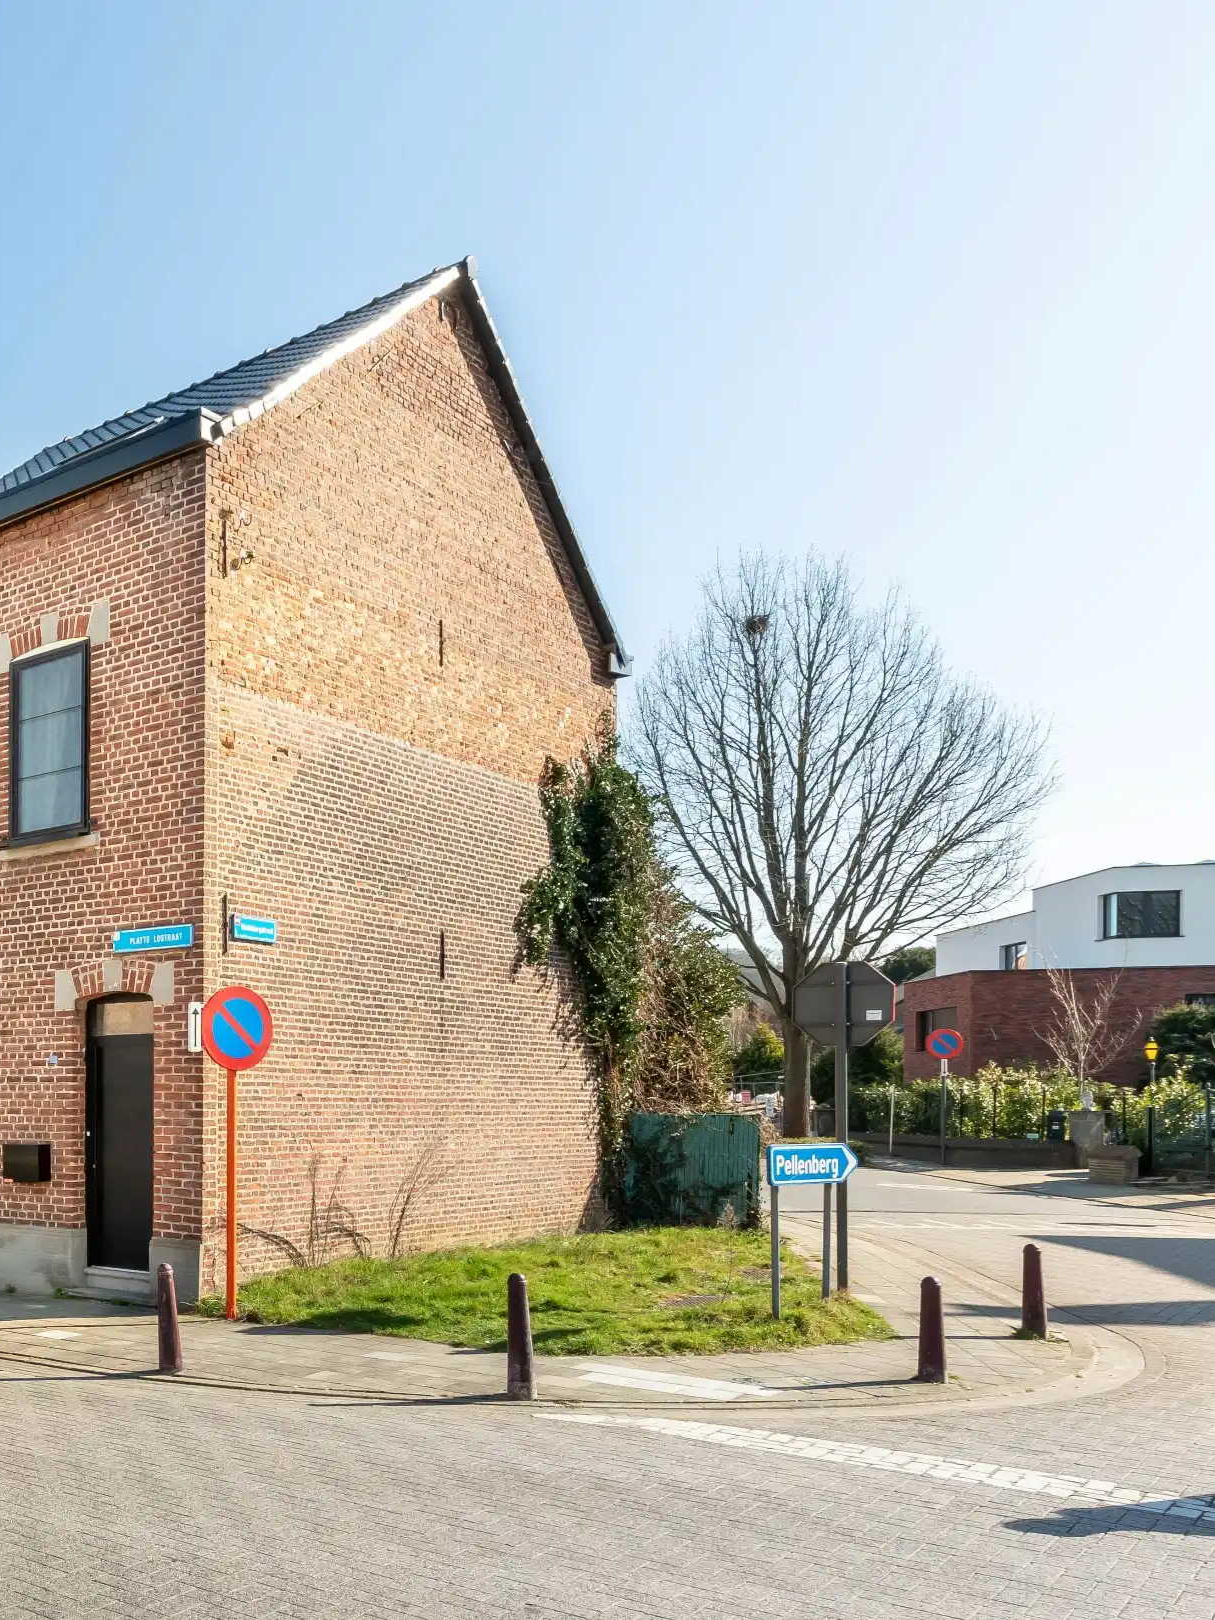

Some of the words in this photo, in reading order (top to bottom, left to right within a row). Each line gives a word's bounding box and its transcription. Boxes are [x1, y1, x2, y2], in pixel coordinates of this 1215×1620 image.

[129, 935, 150, 945] PLATTE
[153, 932, 183, 943] LOSTRAAT
[775, 1153, 839, 1179] Pellenberg
